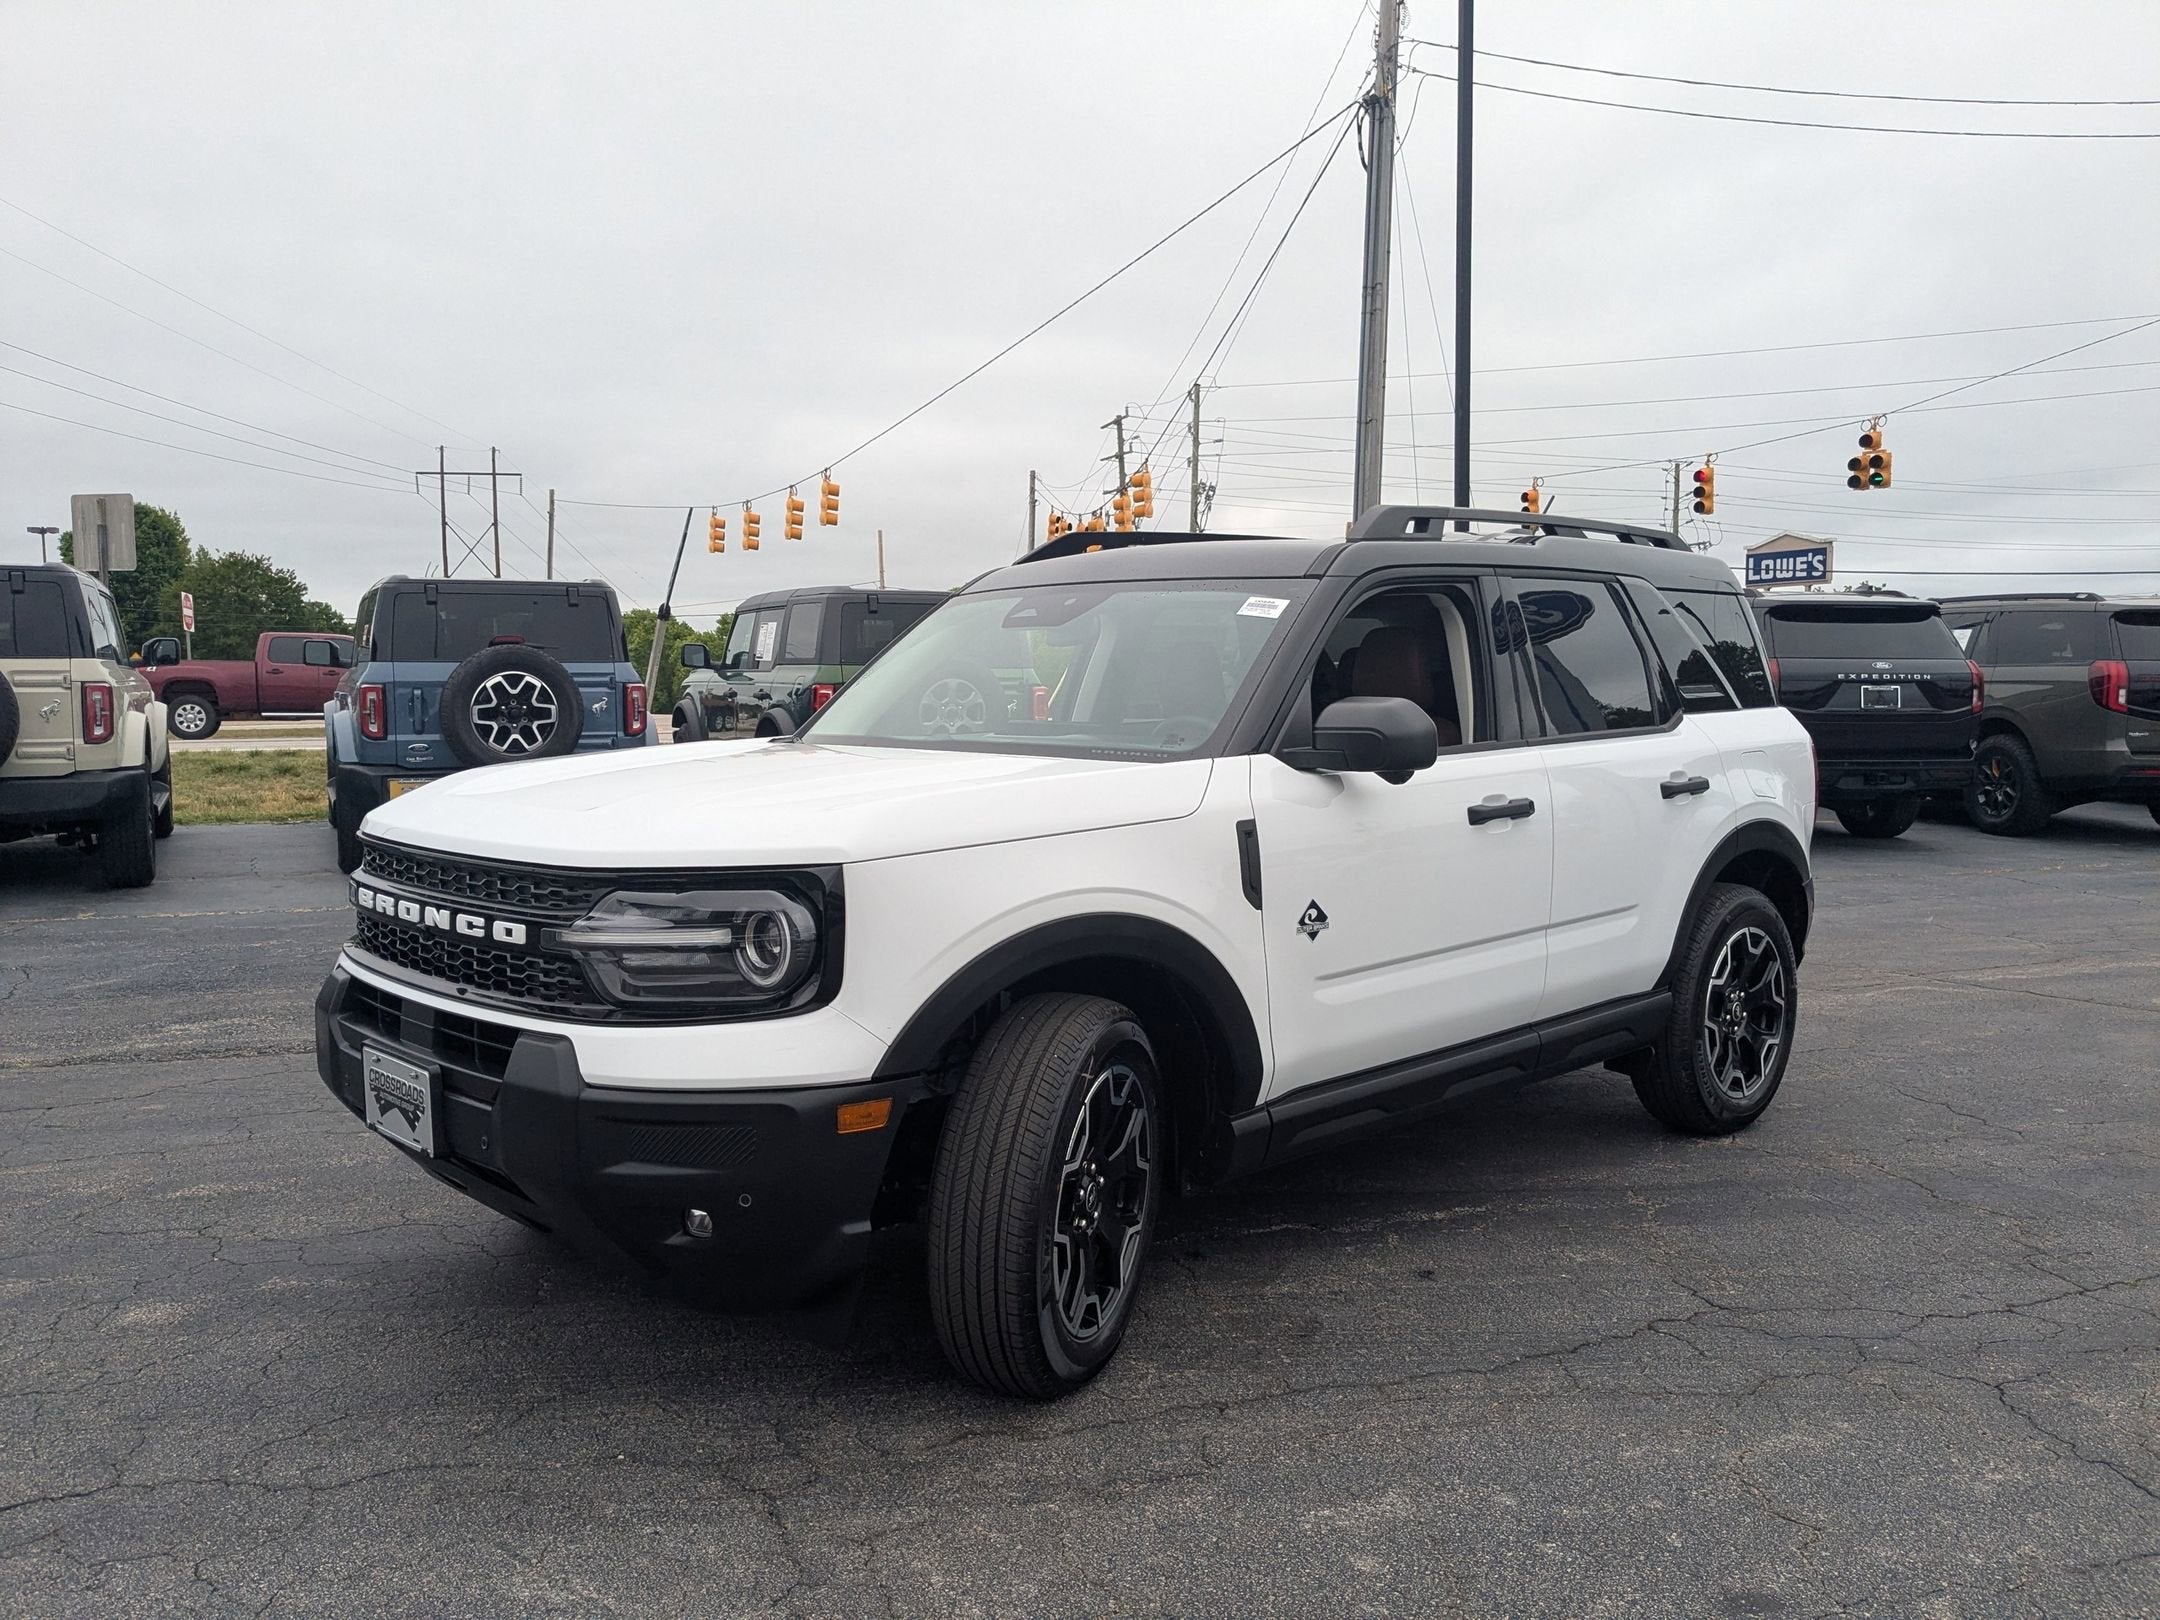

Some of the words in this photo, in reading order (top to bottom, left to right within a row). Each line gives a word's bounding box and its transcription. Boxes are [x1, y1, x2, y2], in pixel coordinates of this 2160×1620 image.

[1748, 552, 1825, 581] LOWE'S
[358, 887, 527, 945] BRONCO
[369, 1067, 425, 1105] CROSSROADS
